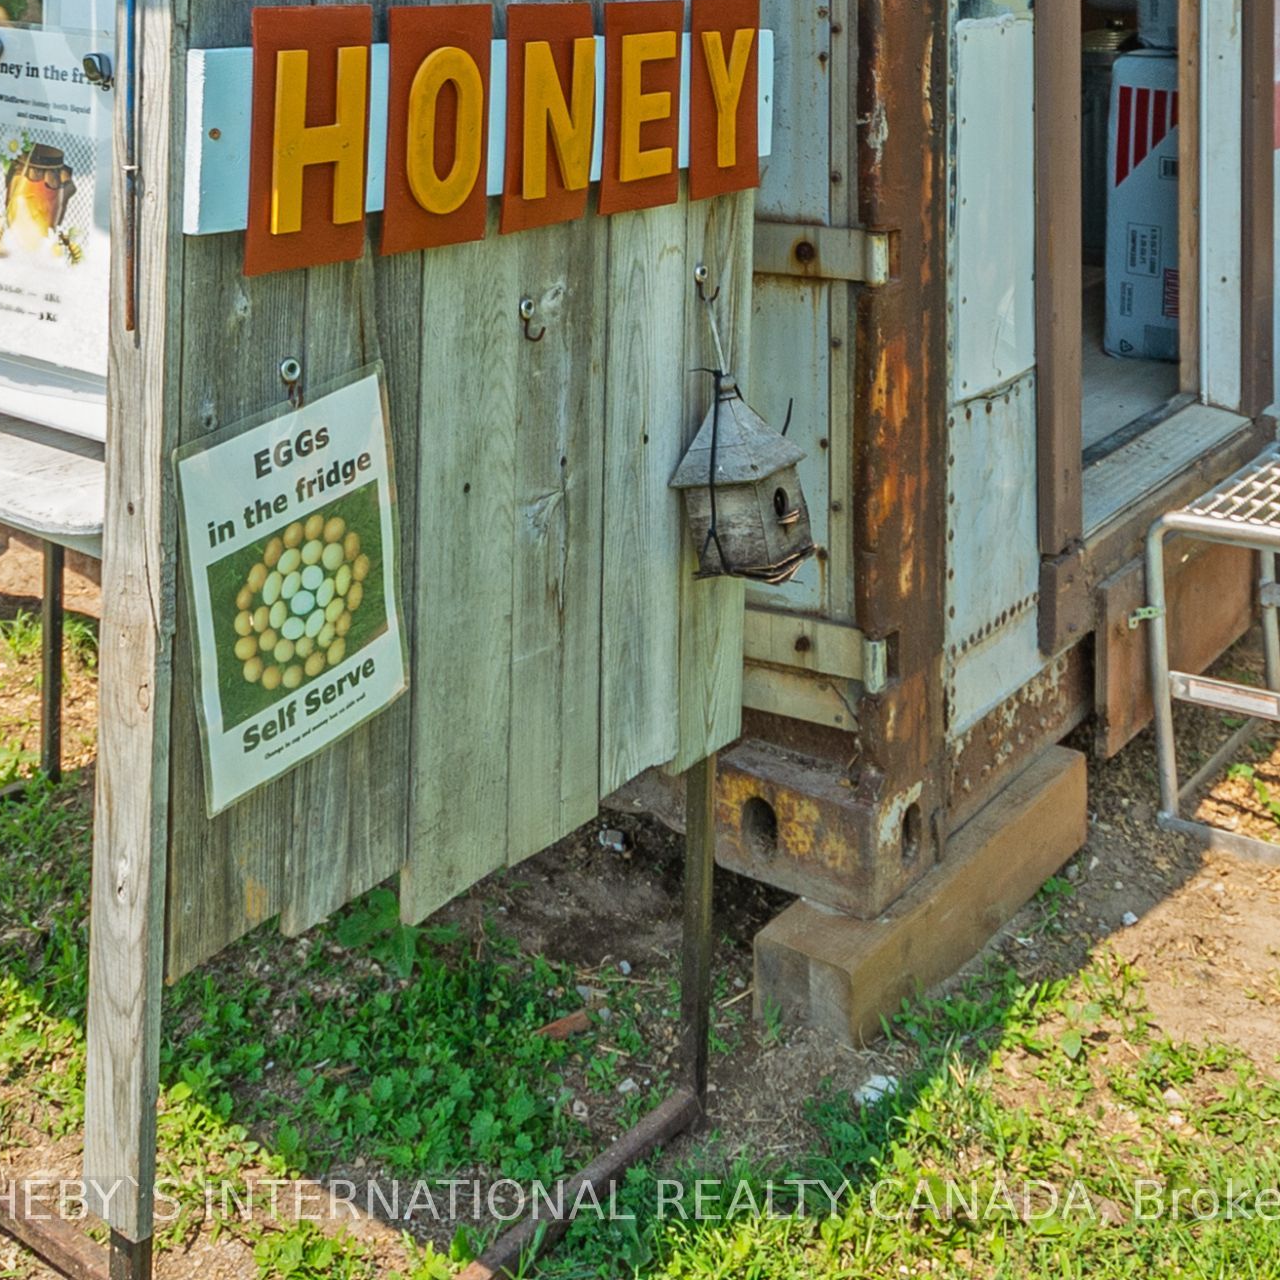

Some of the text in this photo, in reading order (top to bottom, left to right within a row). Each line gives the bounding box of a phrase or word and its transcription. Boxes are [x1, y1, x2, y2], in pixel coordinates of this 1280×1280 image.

[25, 61, 40, 77] in
[43, 62, 69, 81] the
[270, 27, 756, 236] HONEY
[207, 450, 372, 549] in the fridge
[242, 700, 299, 754] Self
[306, 656, 376, 715] Serve
